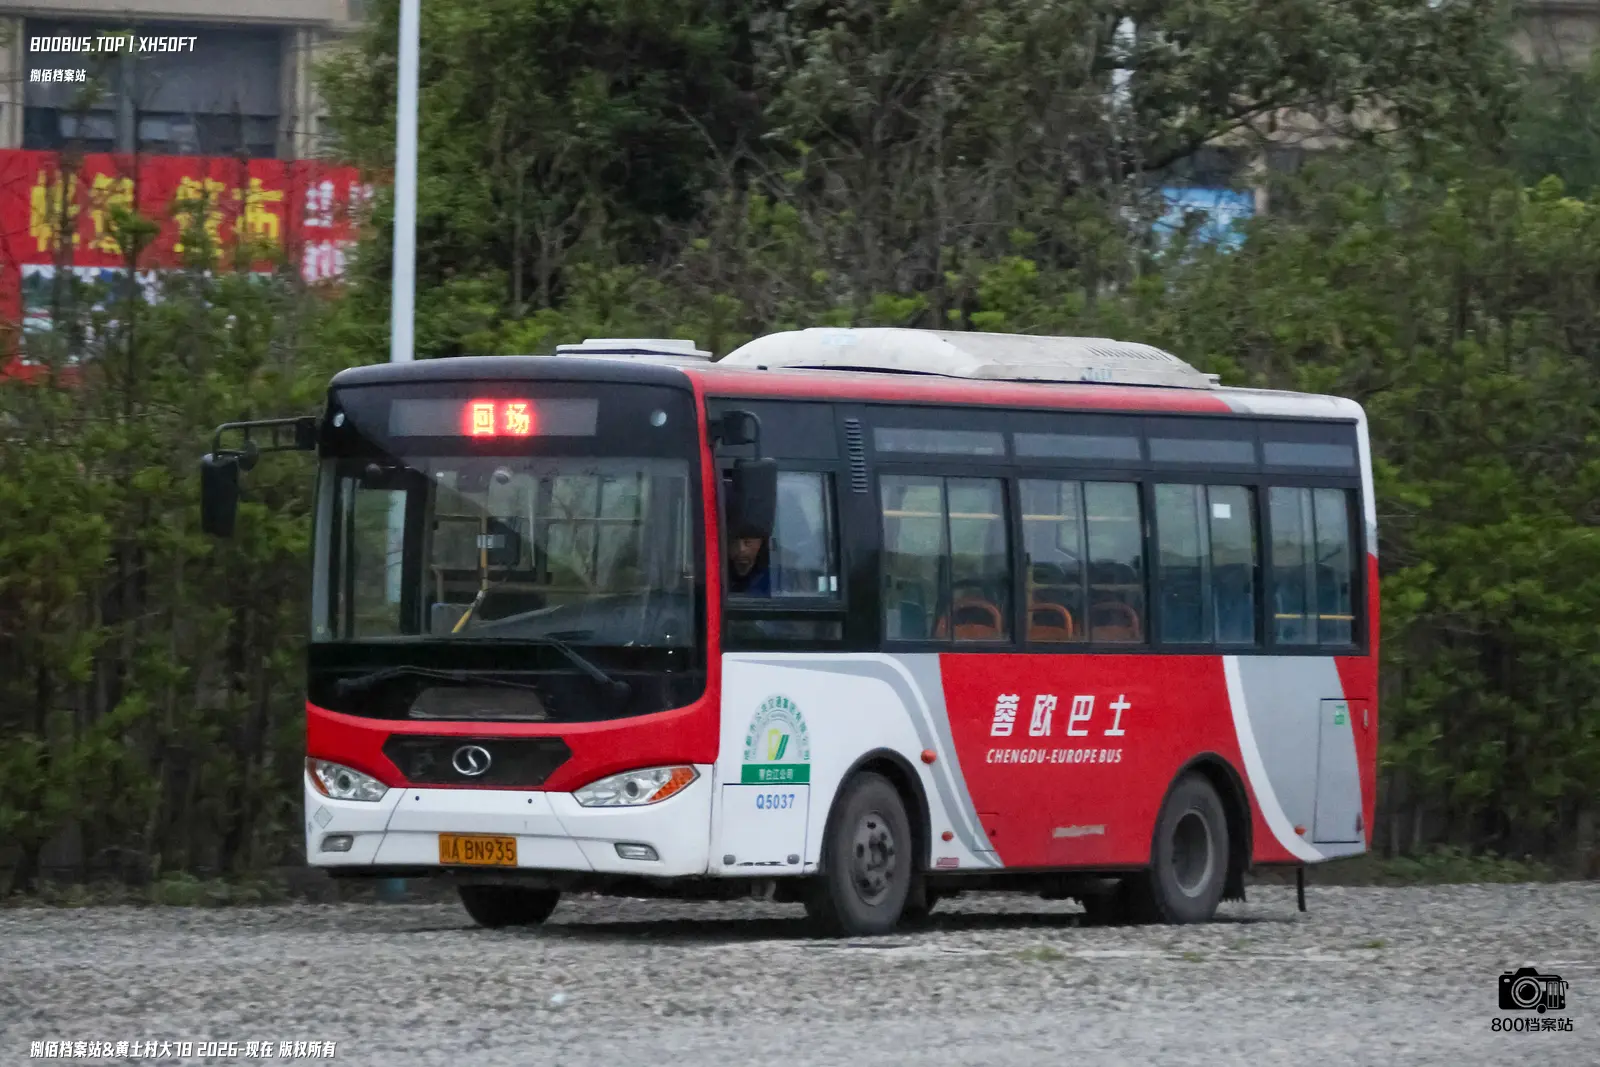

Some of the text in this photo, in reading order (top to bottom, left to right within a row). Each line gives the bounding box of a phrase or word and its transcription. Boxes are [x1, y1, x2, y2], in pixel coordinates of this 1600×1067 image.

[472, 403, 531, 435] 回场
[990, 693, 1132, 737] 蓉欧巴士
[986, 748, 1124, 764] CHENGDU-EUROPE BUS
[756, 793, 796, 810] Q5037
[464, 840, 515, 861] BN935
